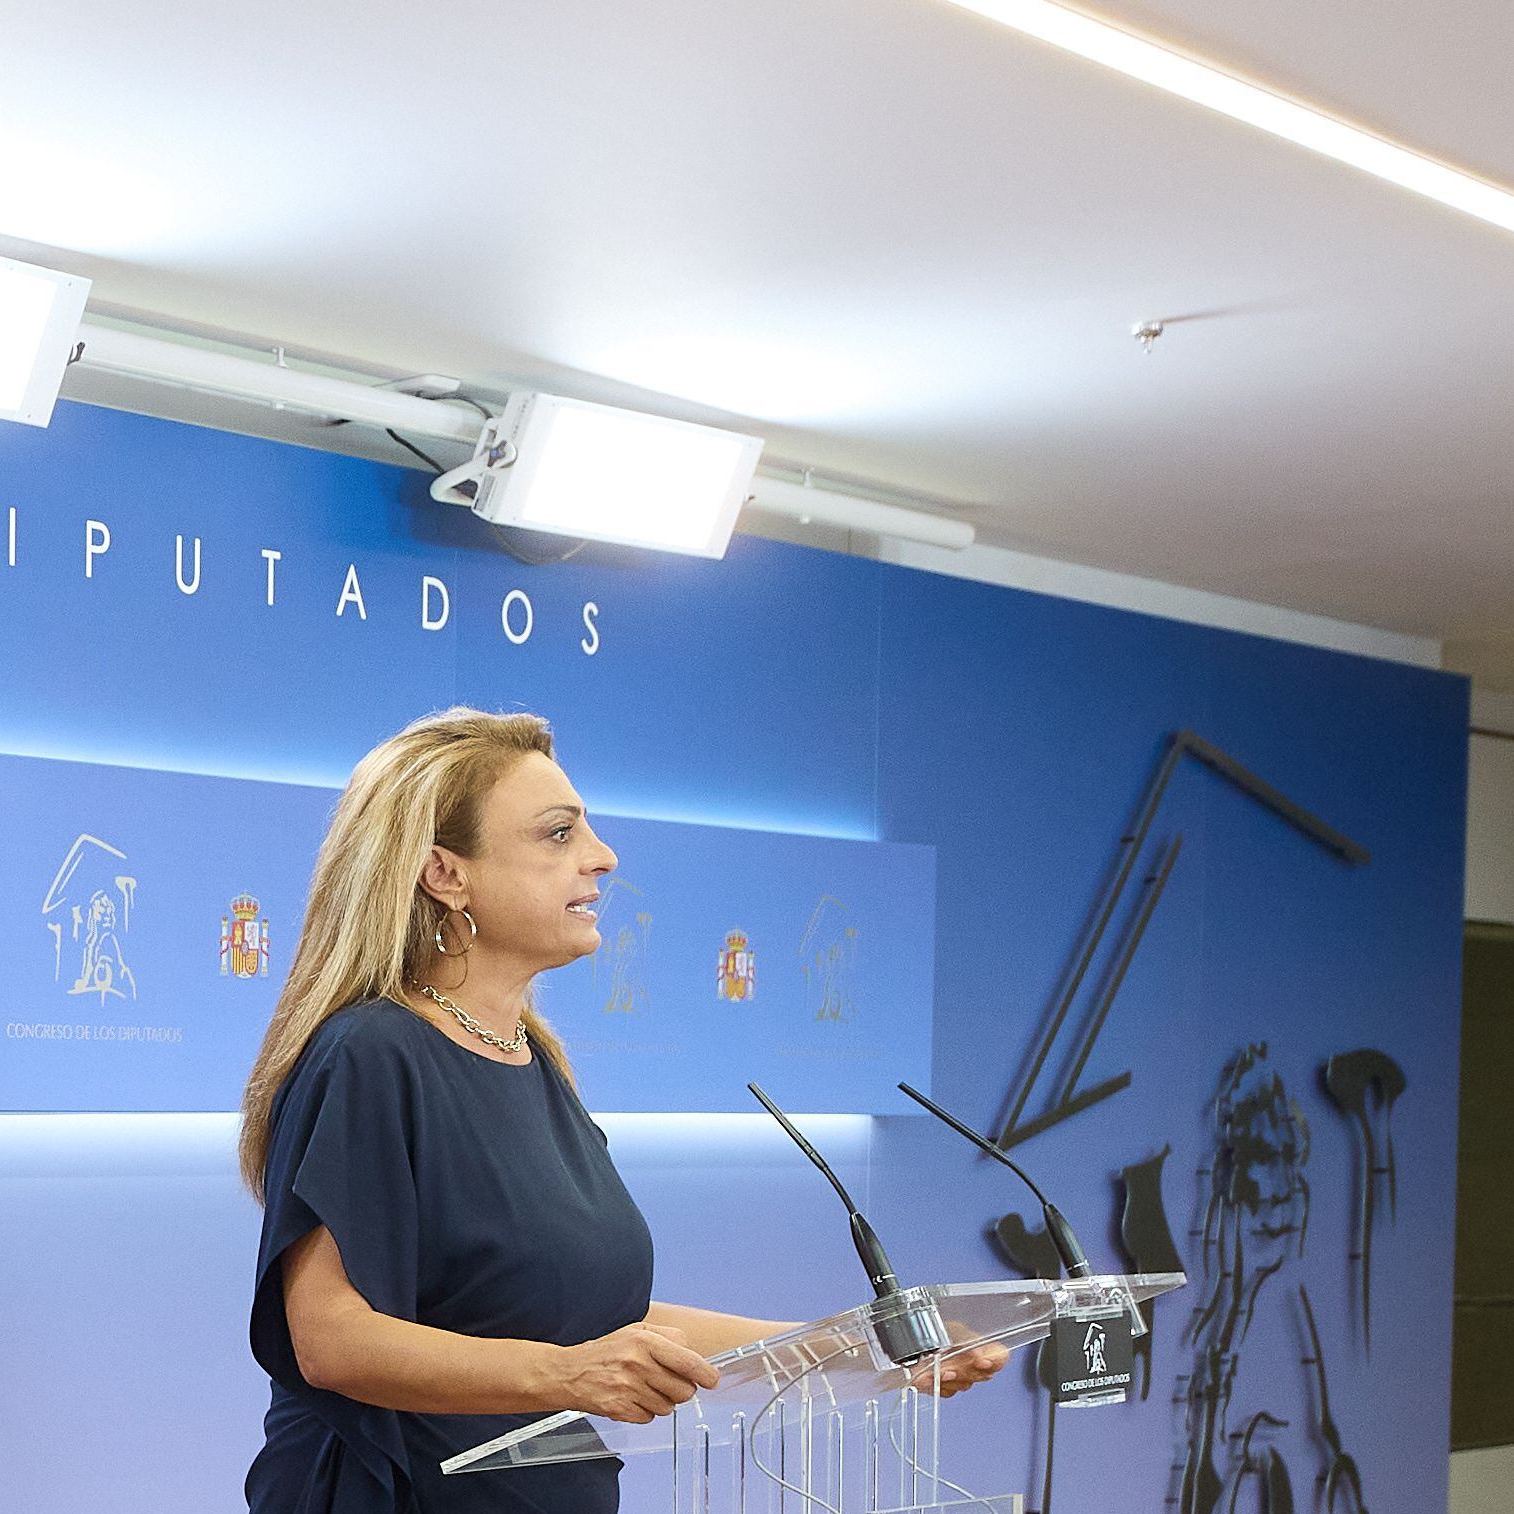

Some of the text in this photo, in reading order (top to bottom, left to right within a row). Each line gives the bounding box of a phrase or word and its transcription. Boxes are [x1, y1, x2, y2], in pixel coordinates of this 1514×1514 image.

[6, 1022, 74, 1040] CONGRESO
[76, 1025, 91, 1040] DE
[94, 1026, 116, 1041] LOS
